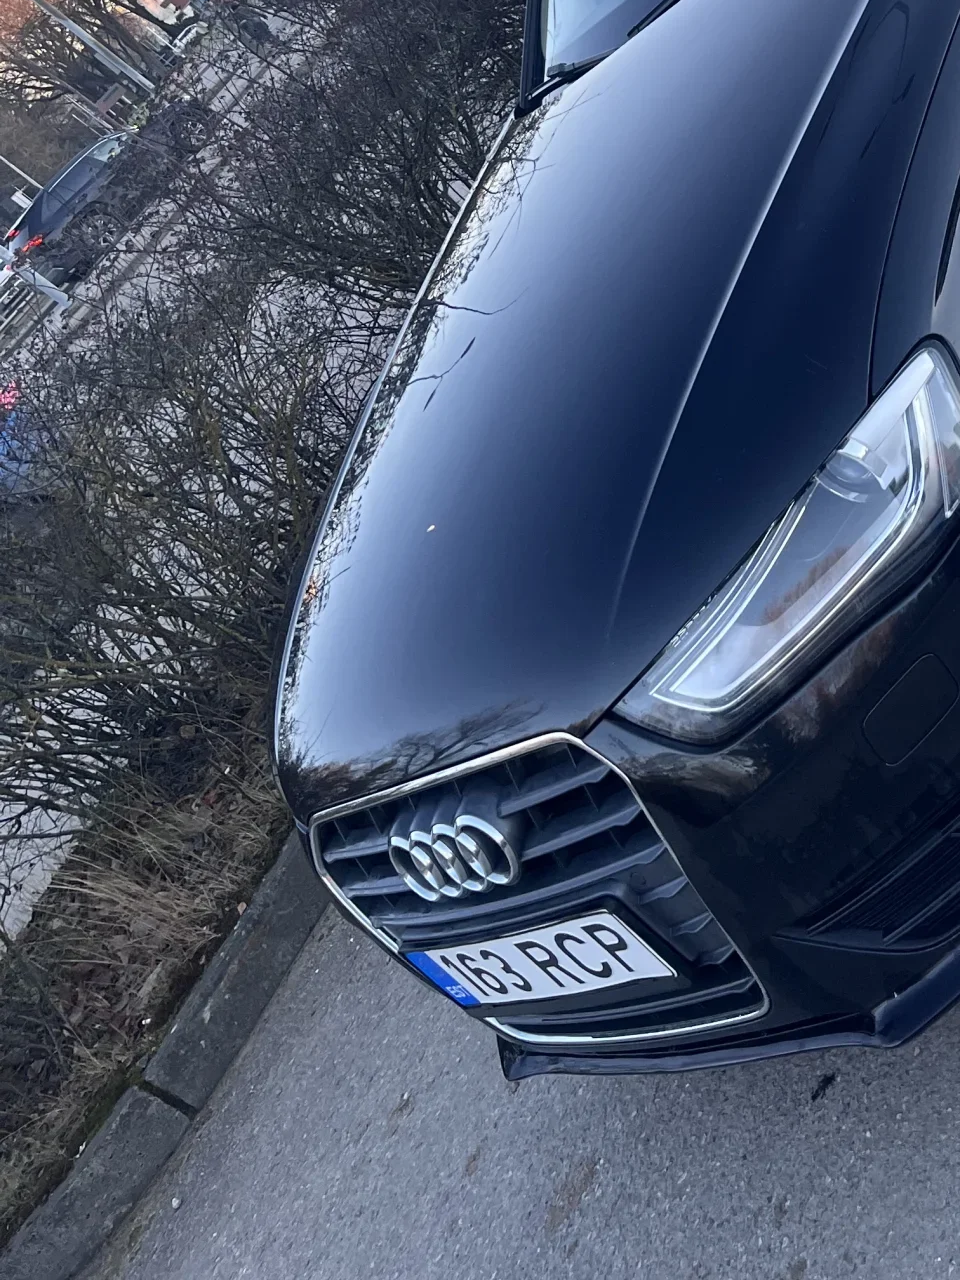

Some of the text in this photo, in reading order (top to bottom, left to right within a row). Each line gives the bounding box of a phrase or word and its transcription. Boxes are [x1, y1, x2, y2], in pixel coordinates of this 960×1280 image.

[440, 923, 635, 997] 163 RCP
[445, 984, 471, 998] EST
